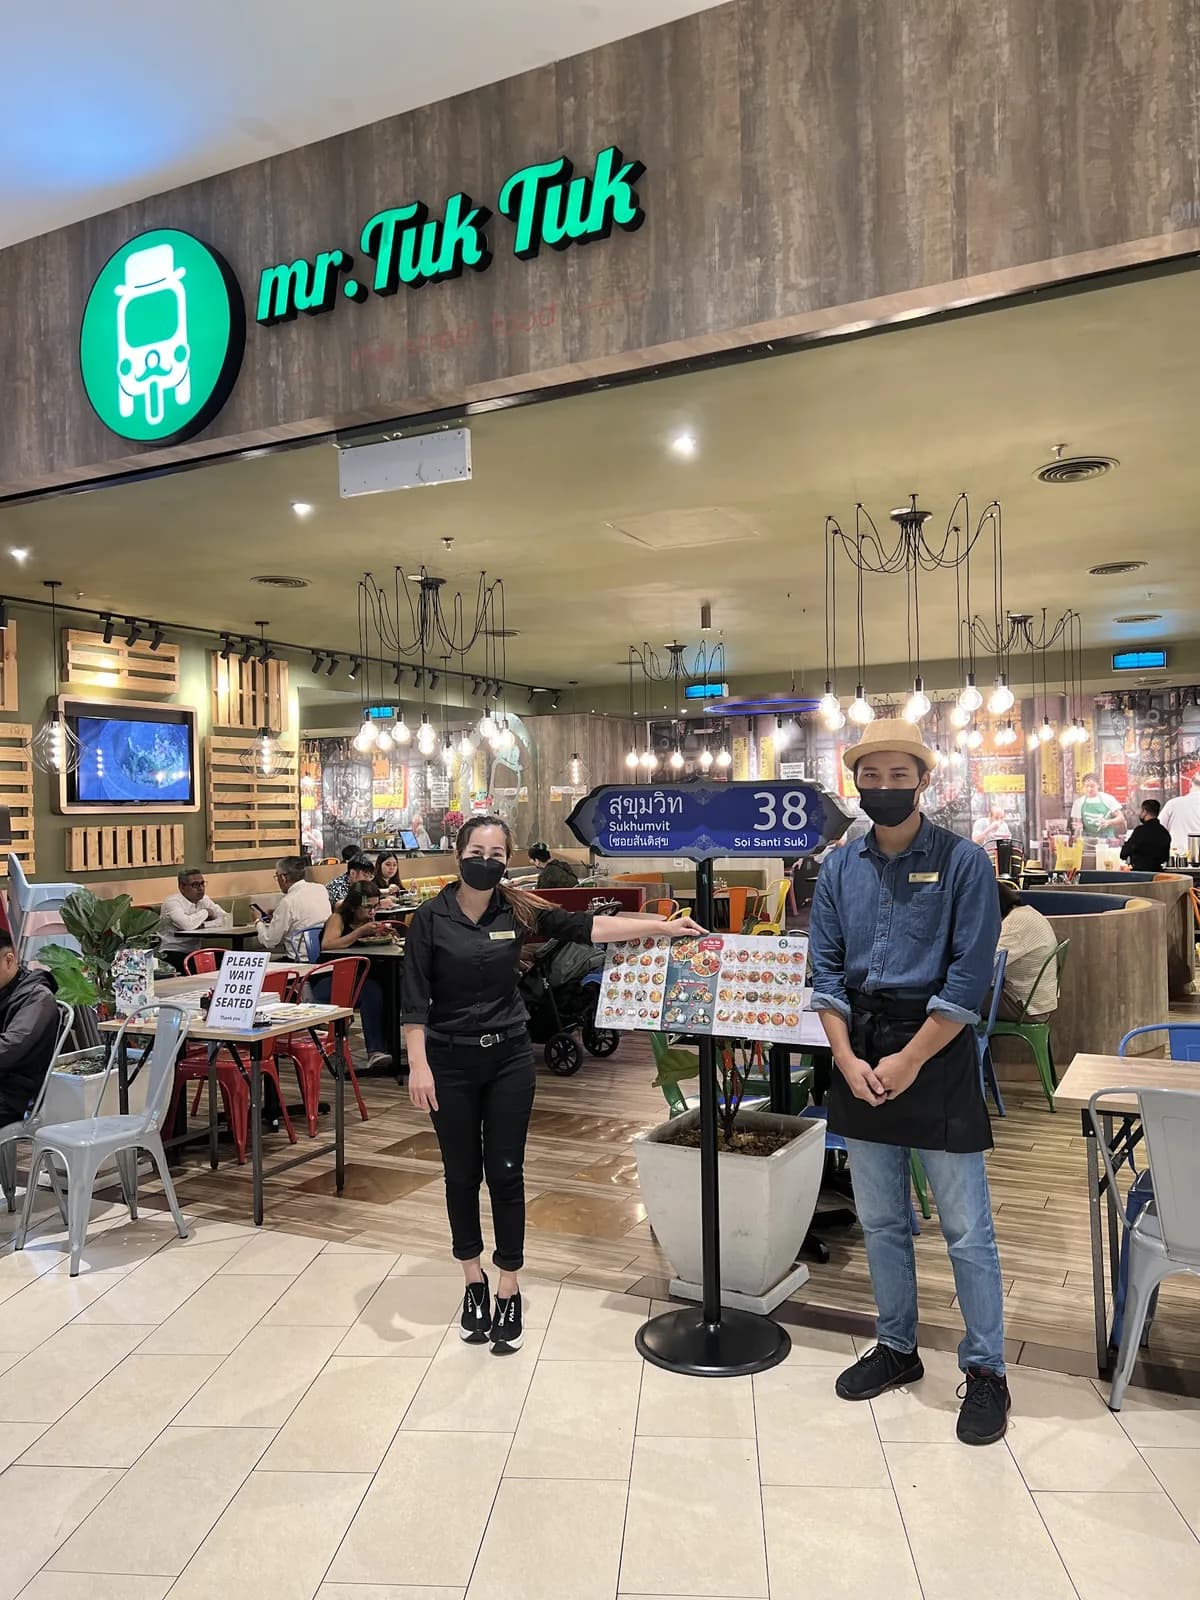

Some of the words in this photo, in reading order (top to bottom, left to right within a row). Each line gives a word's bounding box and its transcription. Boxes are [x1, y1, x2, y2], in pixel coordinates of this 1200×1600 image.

[256, 248, 362, 324] mr.
[360, 192, 488, 294] Tuk
[498, 146, 643, 258] Tuk
[609, 791, 683, 820] สุขุมวิท
[753, 791, 808, 831] 38
[609, 821, 670, 831] Sukhumvit
[734, 837, 751, 848] Soi
[754, 837, 781, 847] Santi
[784, 833, 808, 848] Suk)
[226, 956, 264, 967] PLEASE
[229, 970, 255, 980] WAIT
[224, 984, 237, 993] TO
[239, 985, 252, 994] BE
[215, 997, 253, 1008] SEATED
